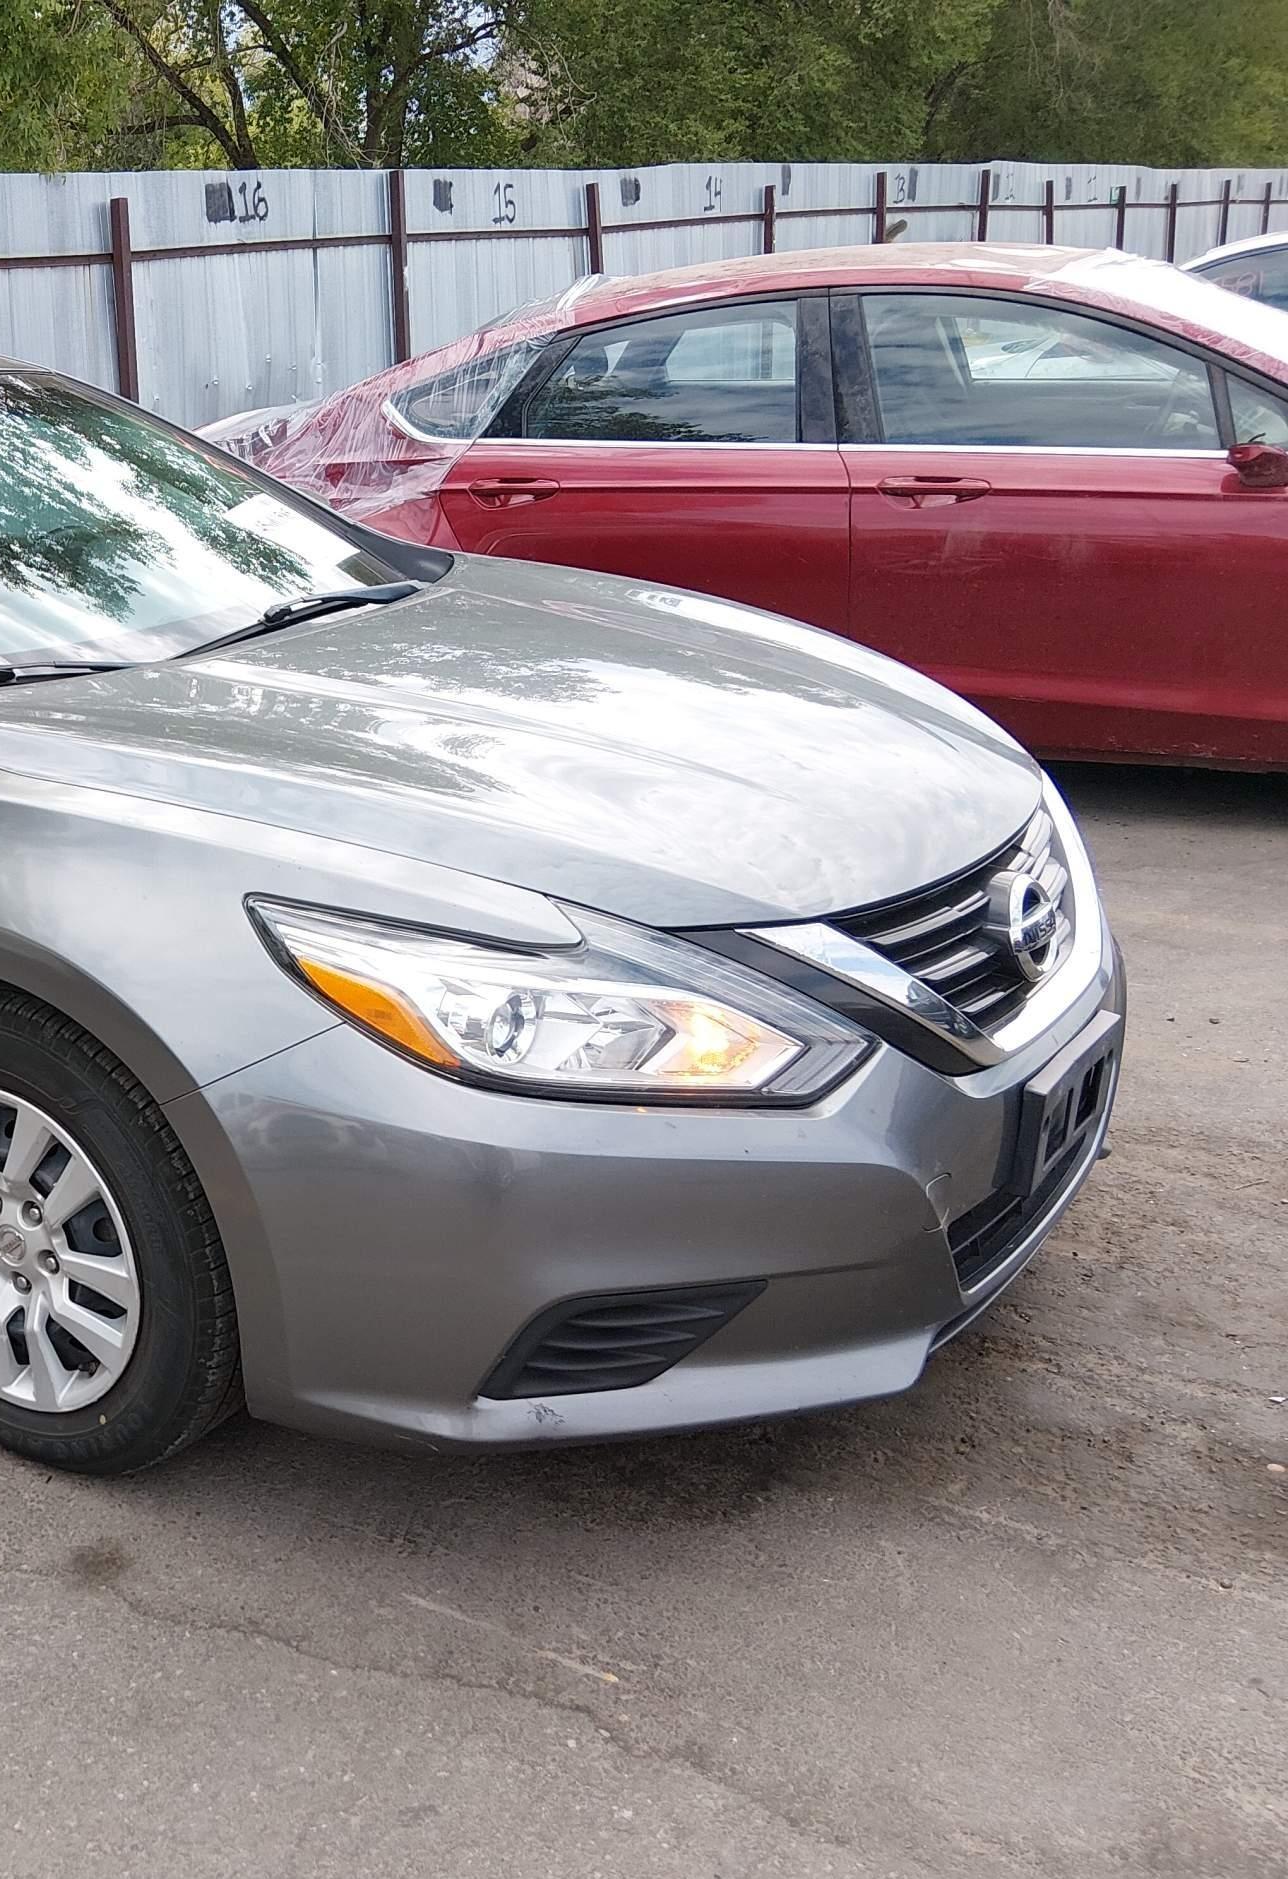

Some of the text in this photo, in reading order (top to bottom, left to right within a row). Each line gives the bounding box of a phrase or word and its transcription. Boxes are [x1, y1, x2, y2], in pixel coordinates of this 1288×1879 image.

[238, 181, 269, 224] 16
[493, 182, 517, 225] 15
[703, 176, 722, 213] 14
